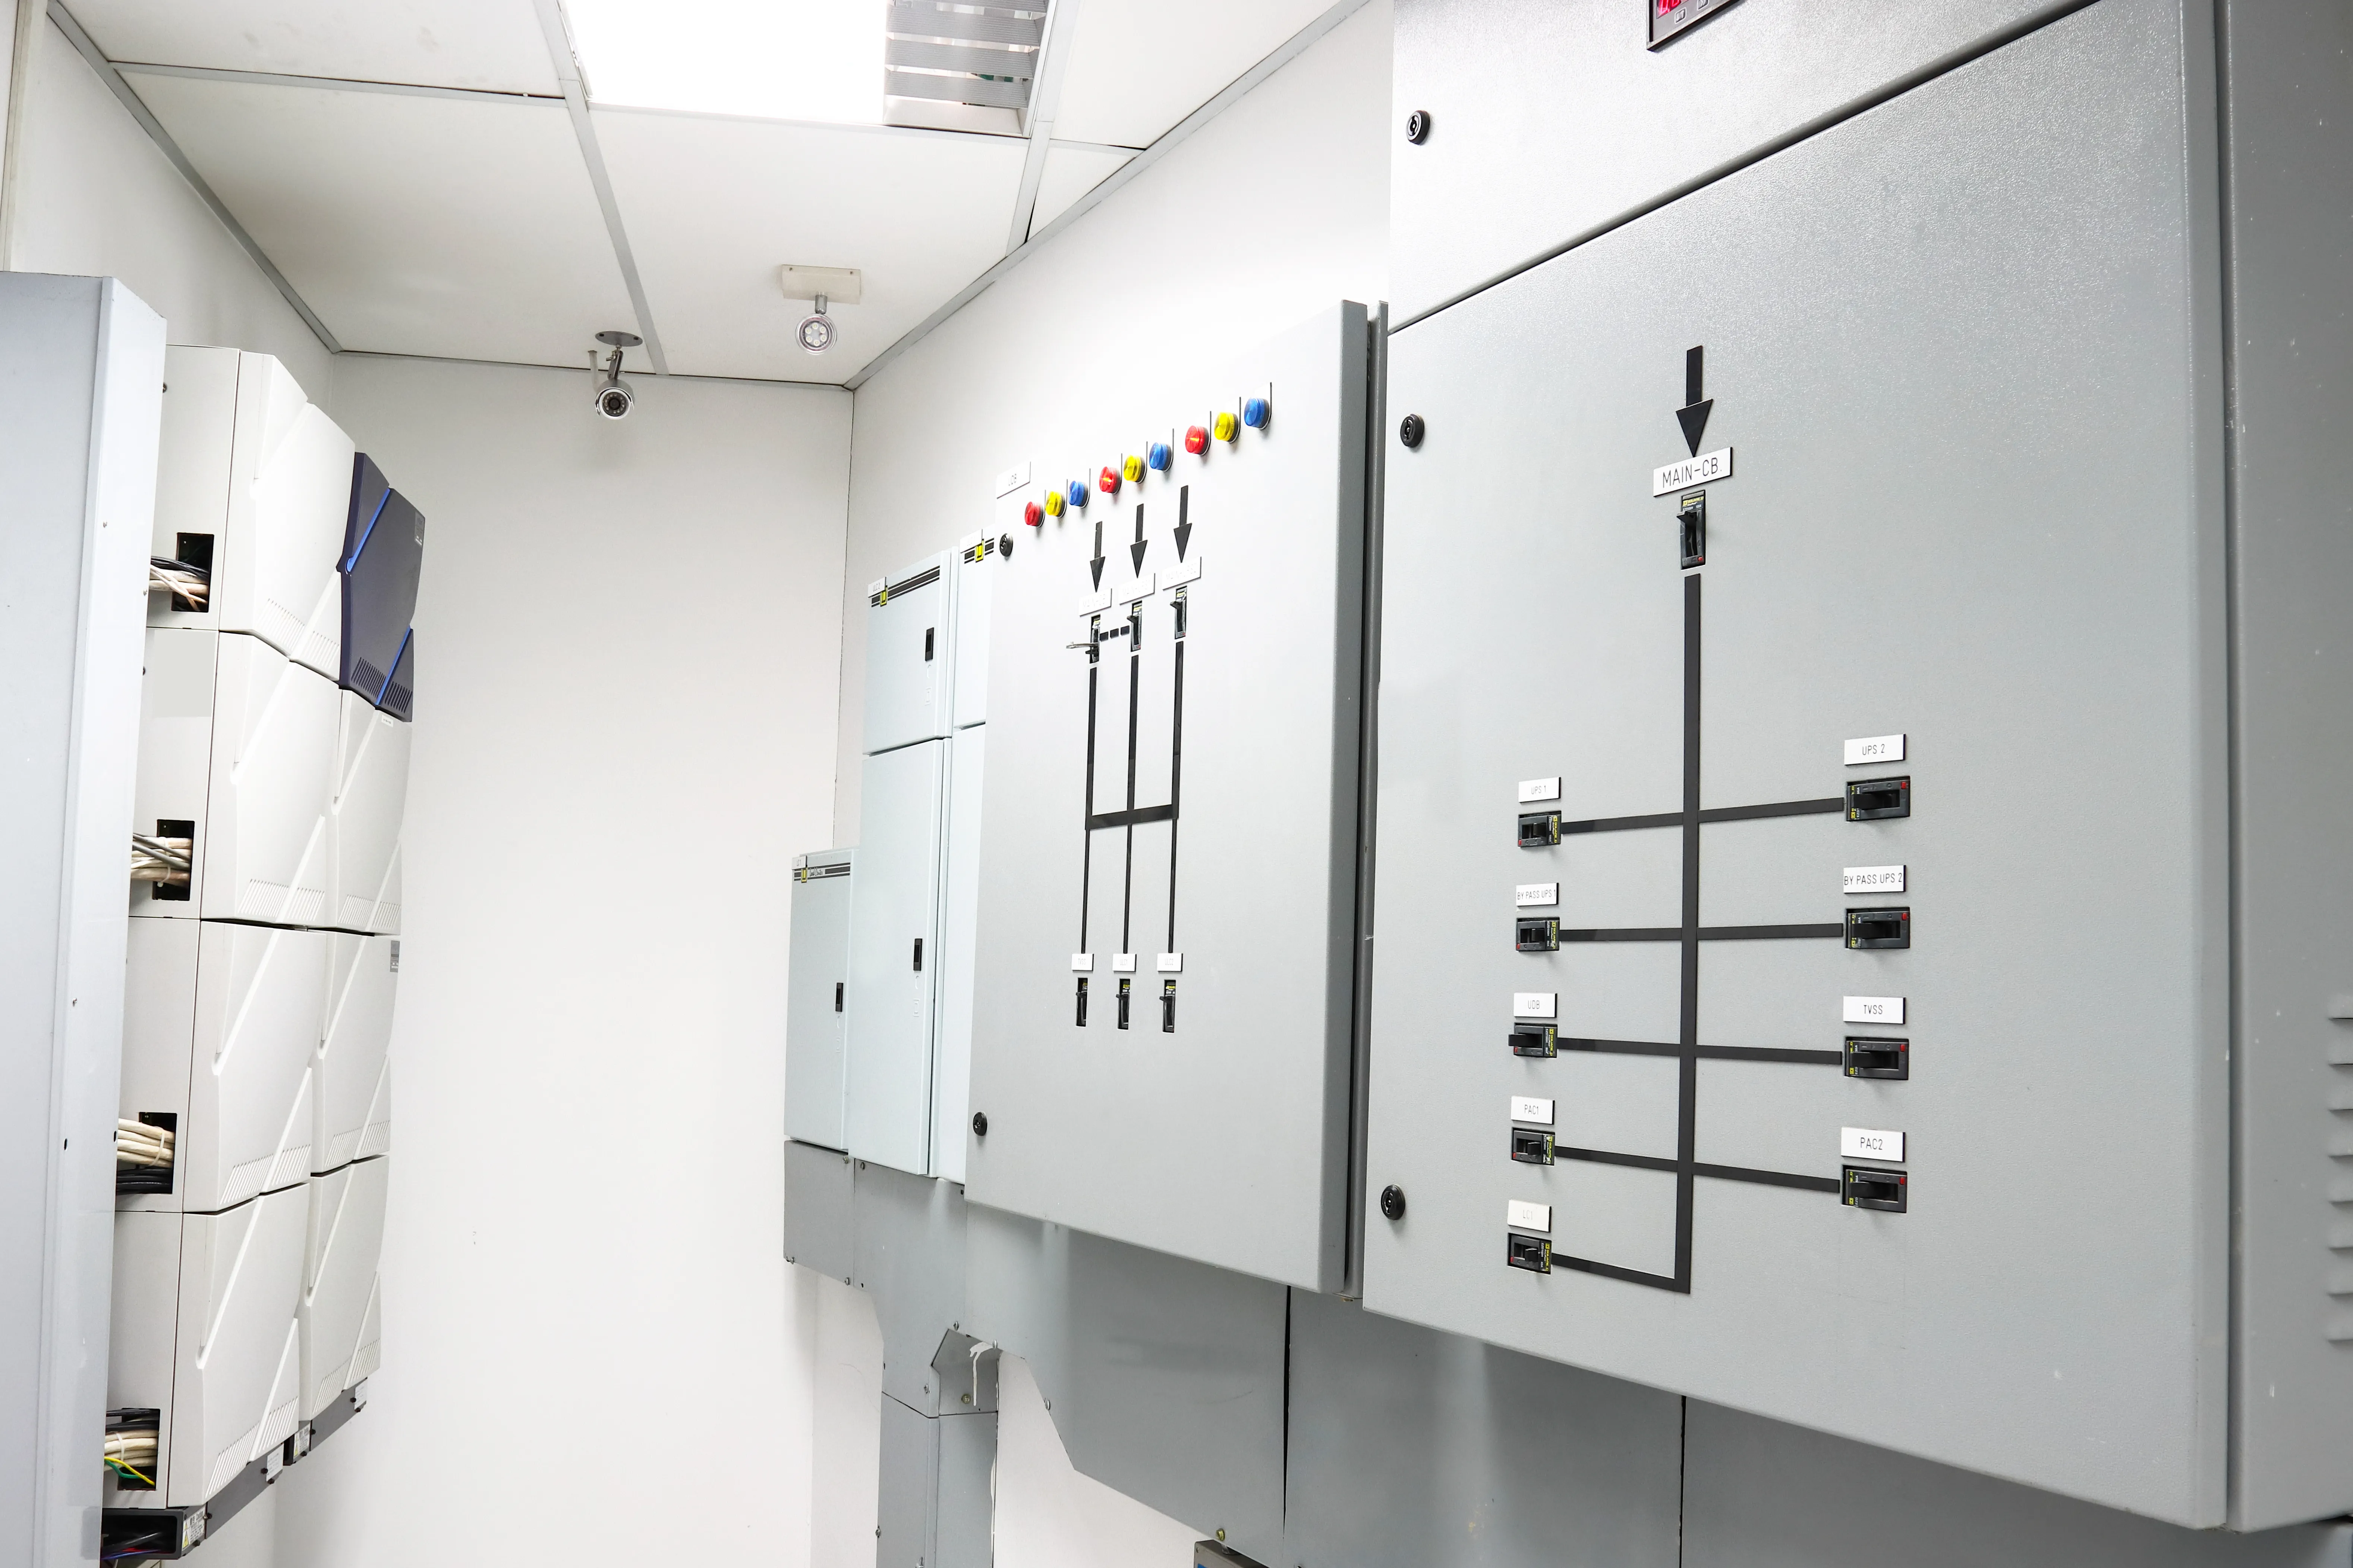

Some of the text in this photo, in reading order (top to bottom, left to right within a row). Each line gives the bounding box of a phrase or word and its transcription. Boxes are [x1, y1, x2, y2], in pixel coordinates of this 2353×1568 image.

[1862, 744, 1885, 755] UPS 2
[1531, 786, 1541, 795] UPS
[1844, 873, 1902, 886] BY PASS UPS 2
[1526, 890, 1539, 899] PASS
[1542, 889, 1552, 898] UPS
[1528, 1000, 1540, 1009] UDB
[1864, 1004, 1883, 1015] TVSS
[1524, 1104, 1539, 1115] PAC1
[1860, 1137, 1883, 1150] PAC2
